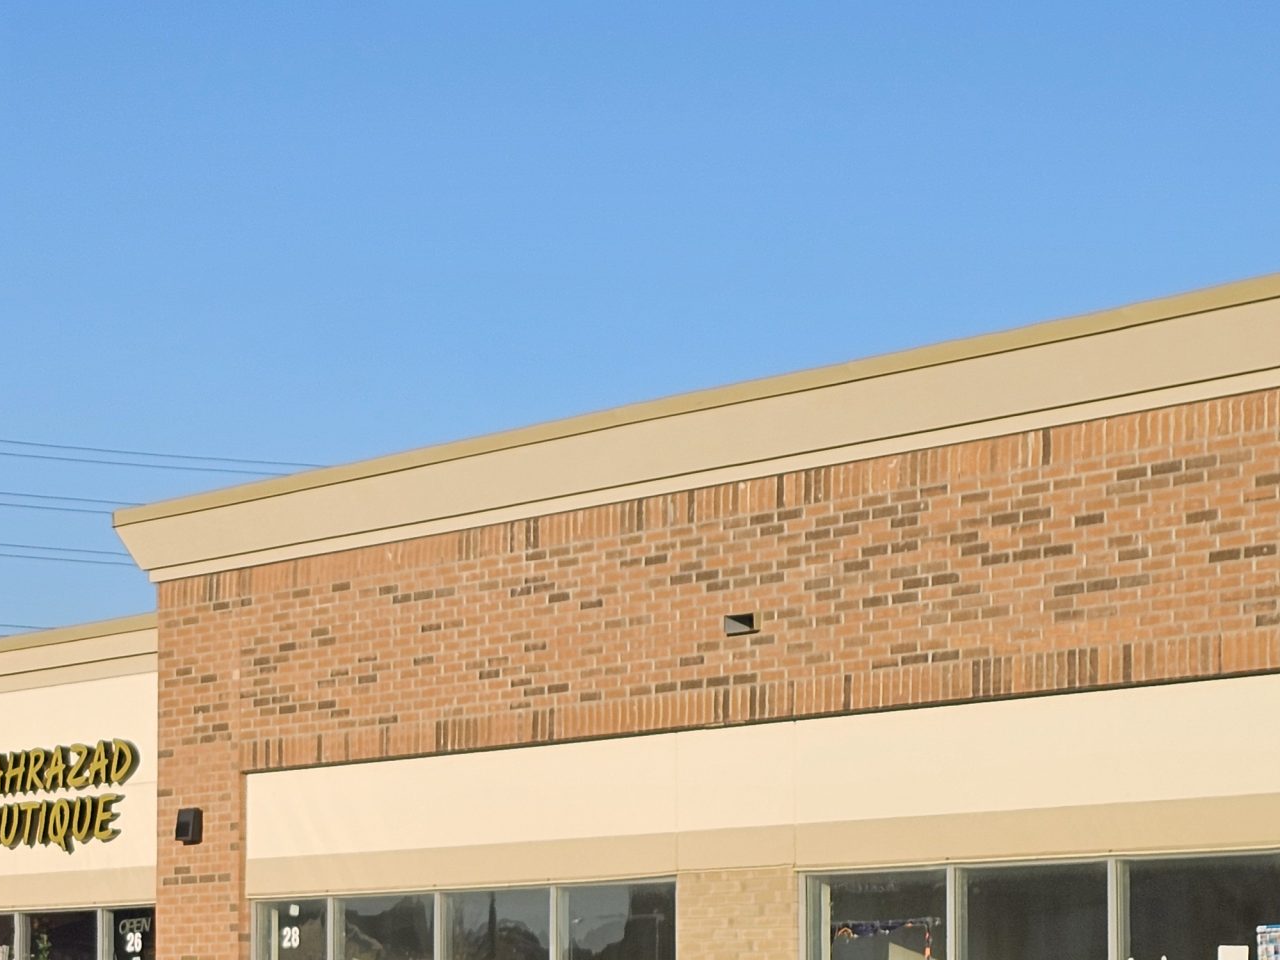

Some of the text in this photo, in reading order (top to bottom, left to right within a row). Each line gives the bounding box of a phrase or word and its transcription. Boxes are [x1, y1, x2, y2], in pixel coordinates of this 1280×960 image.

[118, 917, 151, 934] OPEN
[126, 932, 142, 953] 26
[282, 926, 300, 949] 28
